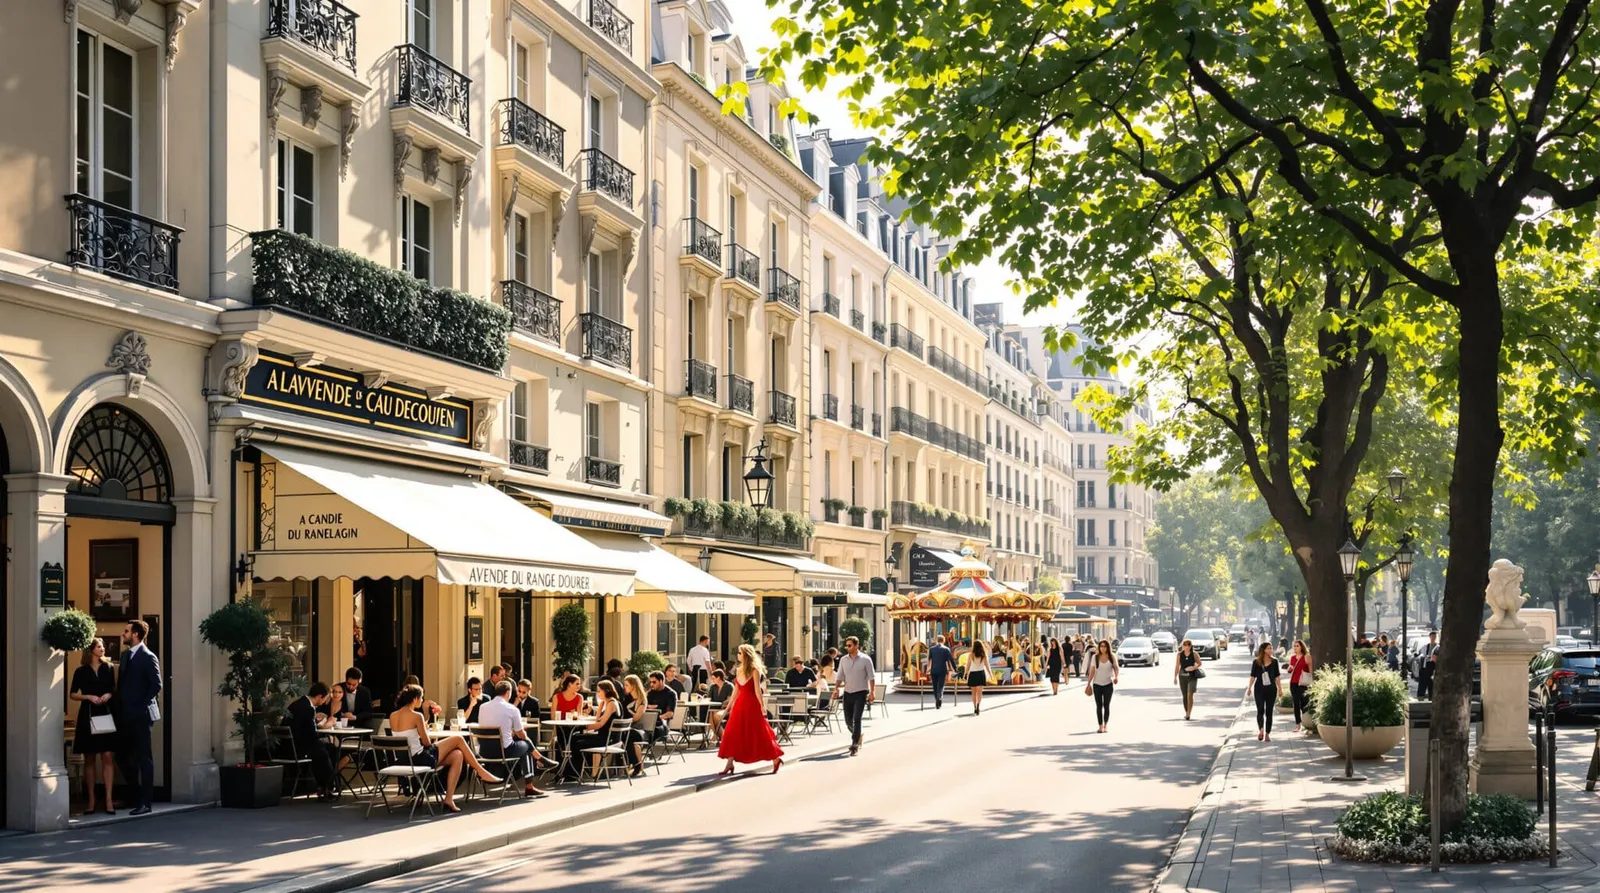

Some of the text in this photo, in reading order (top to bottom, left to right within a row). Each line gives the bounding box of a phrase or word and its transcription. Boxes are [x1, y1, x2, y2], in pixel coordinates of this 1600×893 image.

[299, 513, 343, 525] A CANDIE
[288, 528, 358, 540] DU RANELAGIN
[469, 567, 590, 590] AVENDE DU RANGE DOURER
